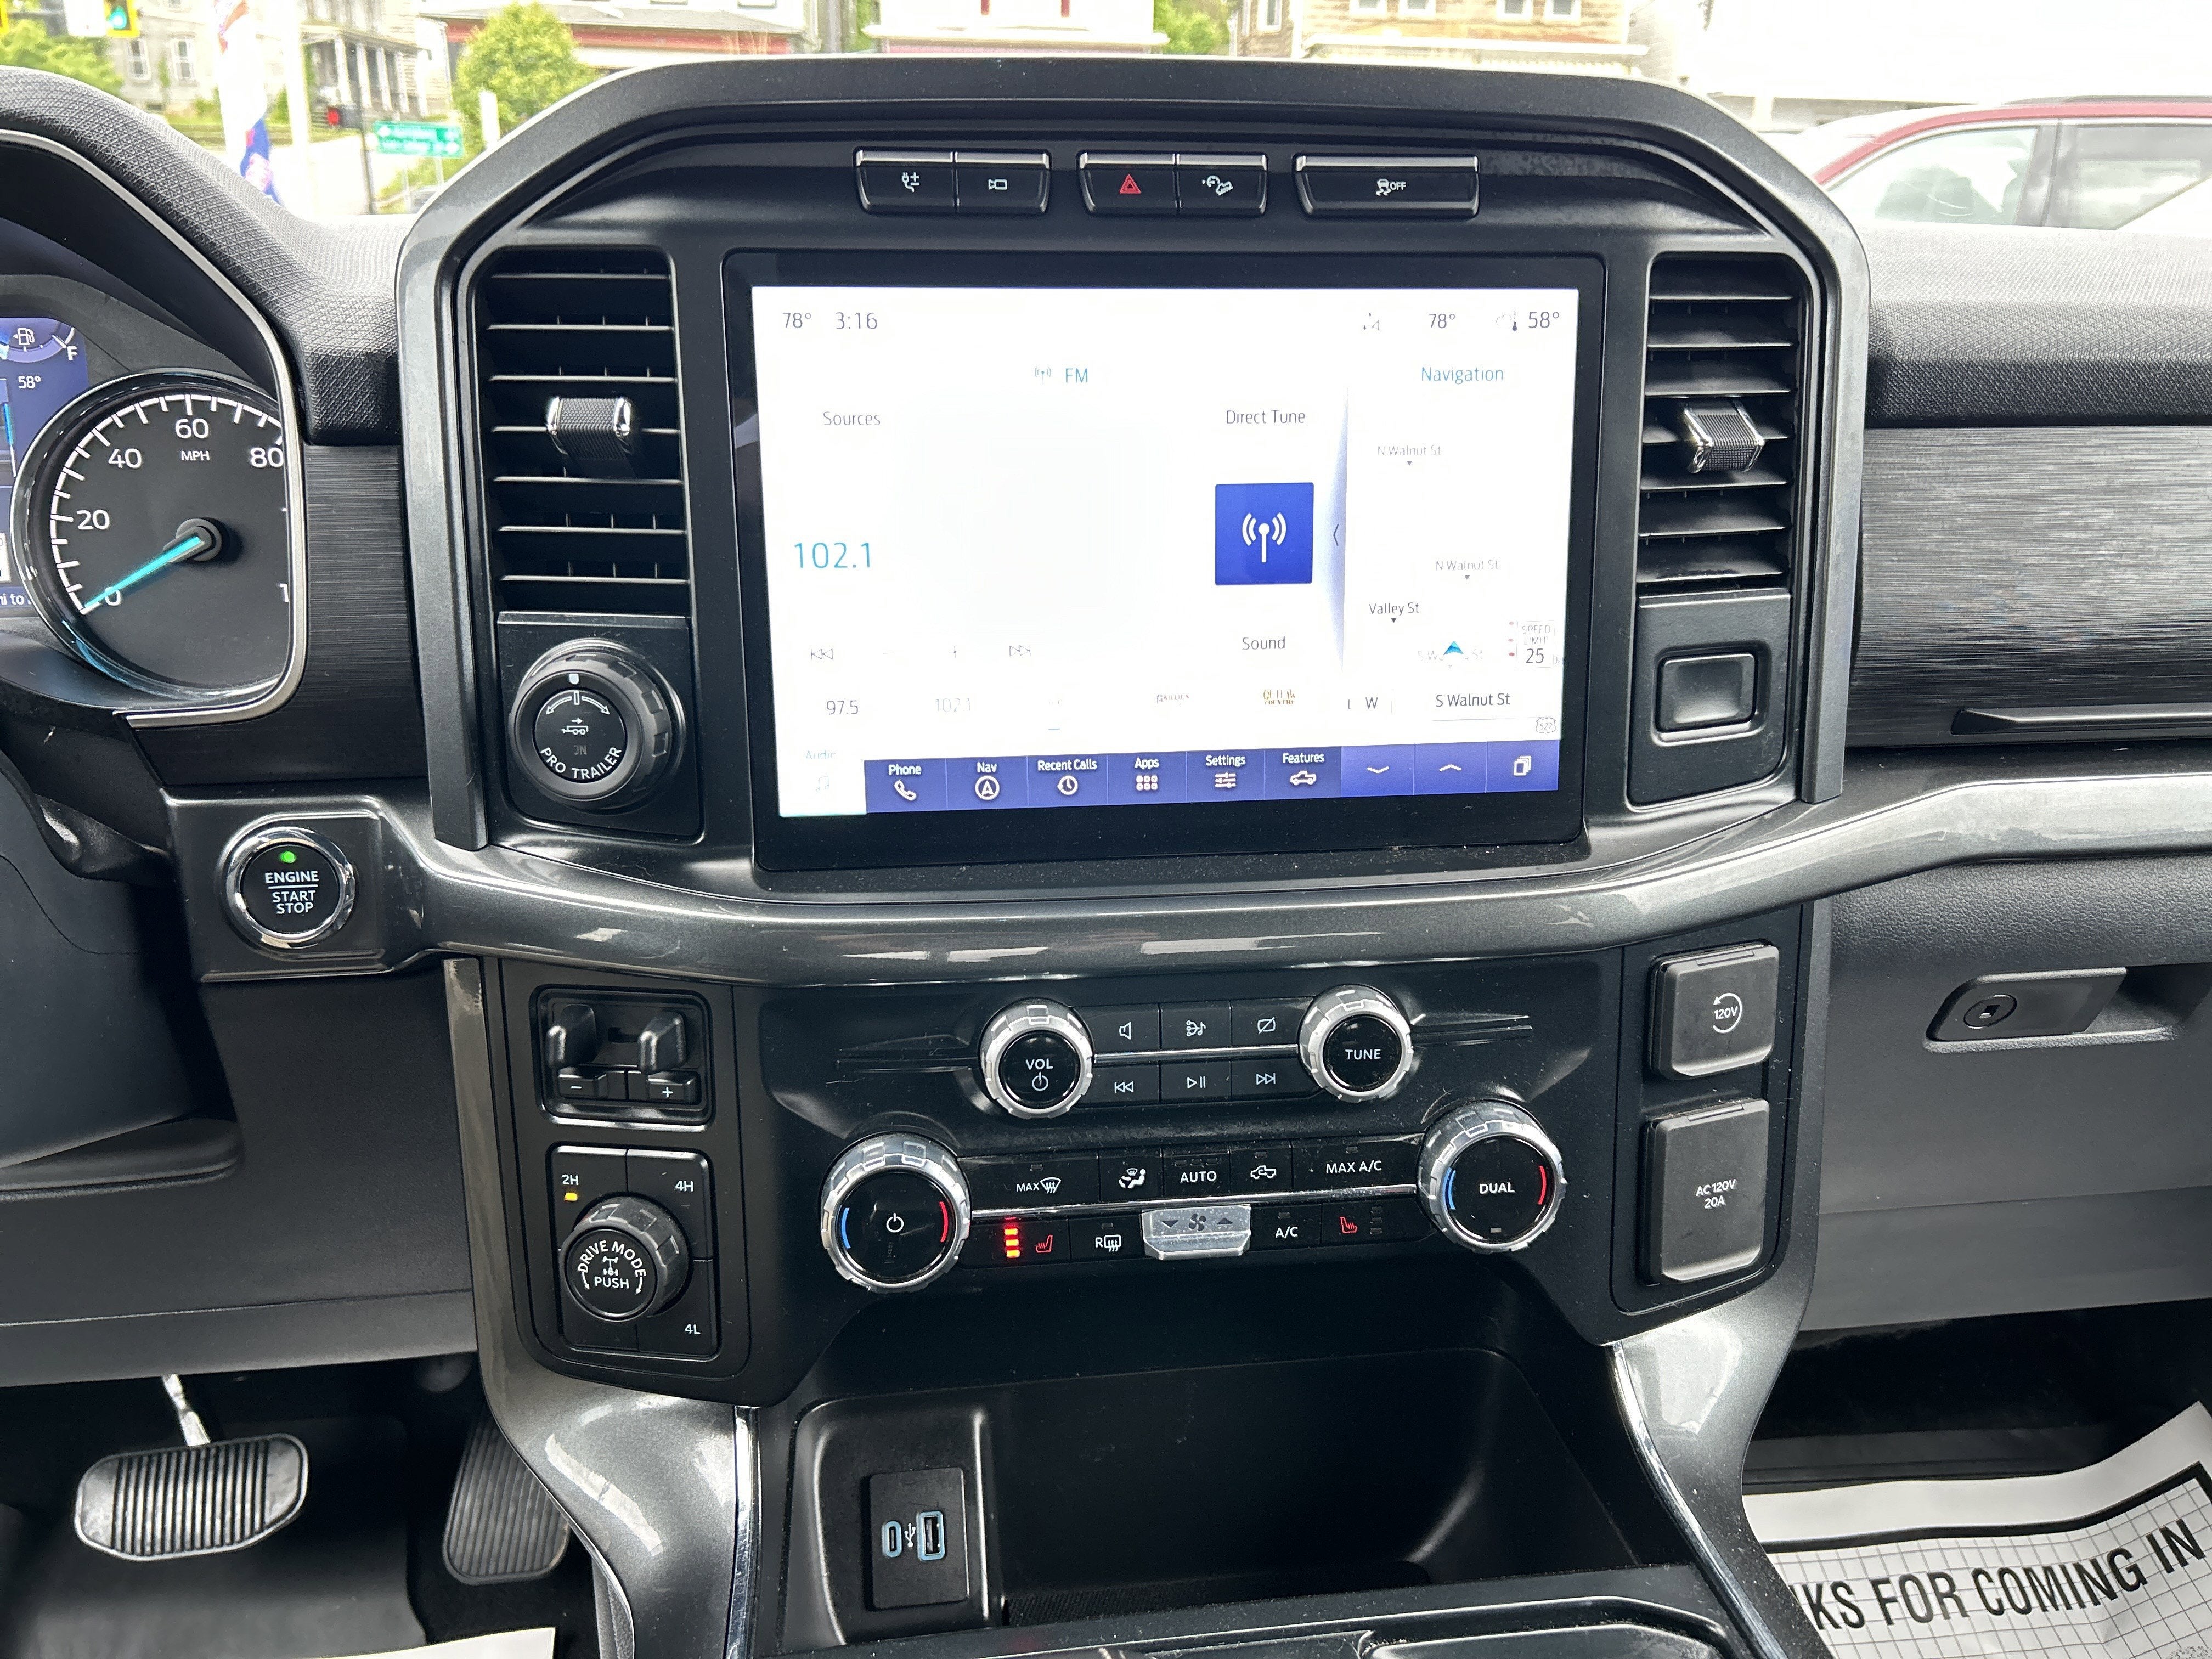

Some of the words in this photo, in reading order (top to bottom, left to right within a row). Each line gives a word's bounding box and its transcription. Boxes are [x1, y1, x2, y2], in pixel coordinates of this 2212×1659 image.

[1390, 182, 1407, 191] OFF
[782, 312, 811, 329] 78°
[835, 312, 878, 330] 3:16
[1429, 313, 1455, 329] 78°
[1528, 311, 1559, 329] 58°
[67, 346, 78, 361] F
[1065, 368, 1088, 383] FM
[1421, 366, 1503, 385] Navigation
[18, 376, 41, 389] 58°
[823, 411, 881, 426] Sources
[1226, 410, 1267, 424] Direct
[1271, 409, 1306, 424] Tune
[175, 418, 209, 439] 60
[180, 450, 210, 461] MPH
[249, 445, 285, 468] 80
[1378, 446, 1385, 456] N
[1388, 445, 1426, 456] Walnut
[1430, 444, 1441, 456] St
[108, 448, 142, 469] 40
[76, 510, 110, 529] 20
[793, 541, 871, 569] 102.1
[1436, 561, 1443, 571] N
[1446, 560, 1484, 571] Walnut
[1488, 559, 1498, 570] St
[9, 593, 25, 605] to
[103, 585, 122, 607] 0
[1369, 602, 1404, 616] Valley
[1407, 602, 1420, 614] St
[1521, 624, 1551, 635] SPEED
[1242, 635, 1285, 650] Sound
[1523, 636, 1548, 646] LIMIT
[1526, 648, 1544, 664] 25
[1365, 696, 1378, 709] W
[1435, 694, 1443, 707] S
[1447, 693, 1493, 707] Walnut
[1497, 692, 1511, 706] St
[826, 699, 859, 715] 97.5
[1539, 722, 1553, 730] 522
[540, 747, 566, 774] PRO
[571, 746, 622, 780] TRAILER
[1037, 759, 1072, 771] Recent
[1073, 758, 1097, 770] Calls
[1135, 757, 1159, 770] Apps
[1205, 755, 1246, 767] Settings
[1282, 753, 1325, 764] Features
[888, 764, 922, 775] Phone
[977, 761, 997, 773] Nav
[264, 871, 319, 884] ENGINE
[272, 890, 316, 902] START
[276, 902, 313, 915] STOP
[1713, 1006, 1739, 1020] 120V
[1345, 1048, 1381, 1060] TUNE
[1025, 1058, 1053, 1070] VOL
[1326, 1161, 1356, 1174] MAX
[1359, 1160, 1381, 1172] A/C
[562, 1174, 579, 1186] 2H
[1180, 1170, 1217, 1183] AUTO
[675, 1180, 694, 1192] 4H
[1016, 1182, 1040, 1192] MAX
[1480, 1182, 1515, 1194] DUAL
[1696, 1184, 1711, 1197] AC
[1712, 1178, 1736, 1193] 120V
[1704, 1195, 1726, 1209] 20A
[1275, 1226, 1298, 1239] A/C
[1095, 1237, 1103, 1248] R
[578, 1240, 608, 1273] DRIVE
[612, 1240, 647, 1277] MODE
[594, 1276, 629, 1289] PUSH
[684, 1324, 701, 1335] 4L
[1871, 1571, 1968, 1626] FOR
[1972, 1548, 2147, 1616] COMING
[2145, 1519, 2206, 1573] IN
